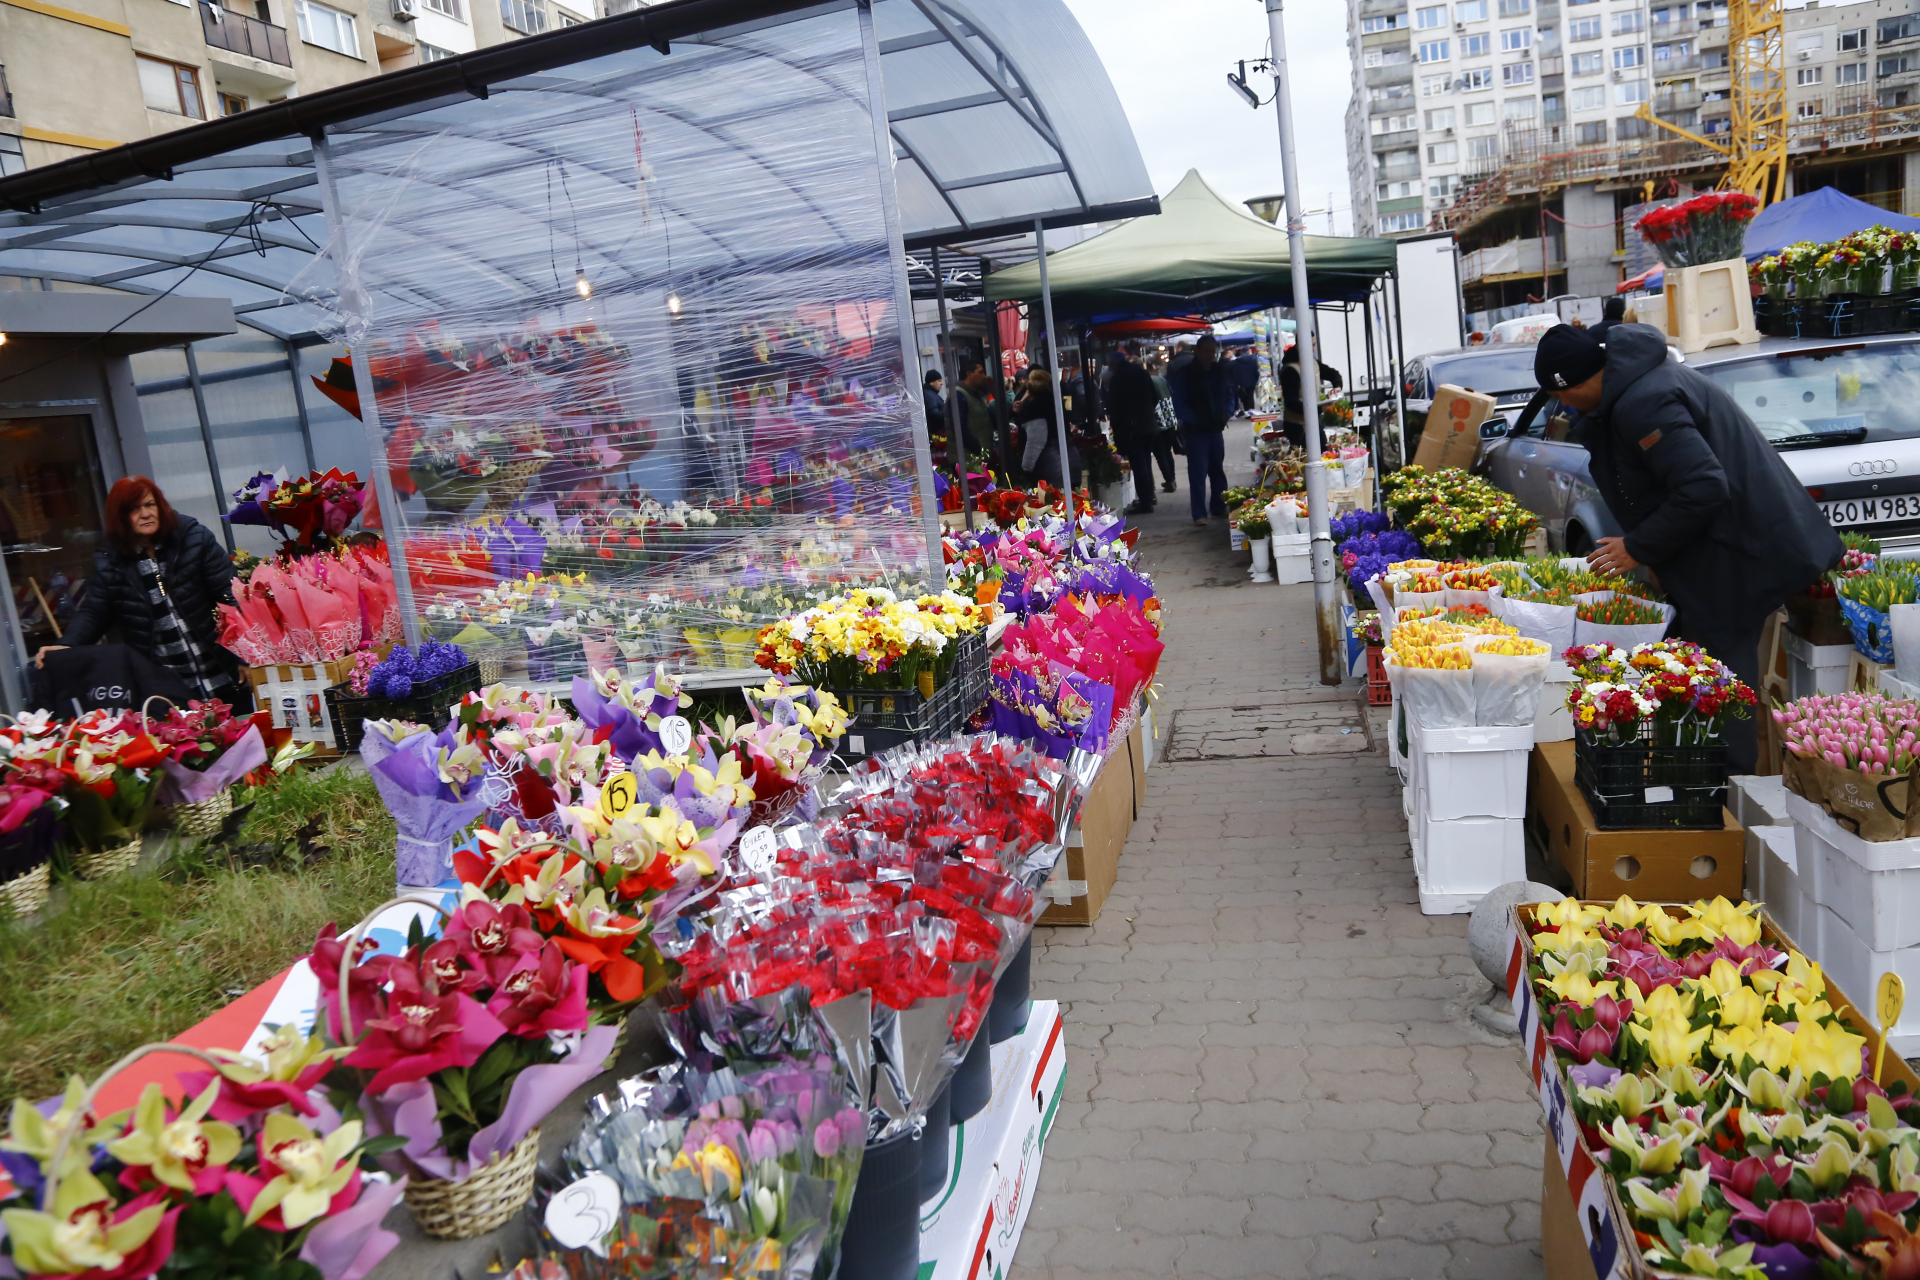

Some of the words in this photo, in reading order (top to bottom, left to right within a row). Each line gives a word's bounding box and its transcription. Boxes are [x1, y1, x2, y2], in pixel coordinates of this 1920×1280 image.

[1862, 500, 1878, 521] M
[1881, 496, 1920, 519] 983
[666, 719, 686, 750] 15
[606, 777, 629, 814] 15
[563, 1186, 611, 1242] 3
